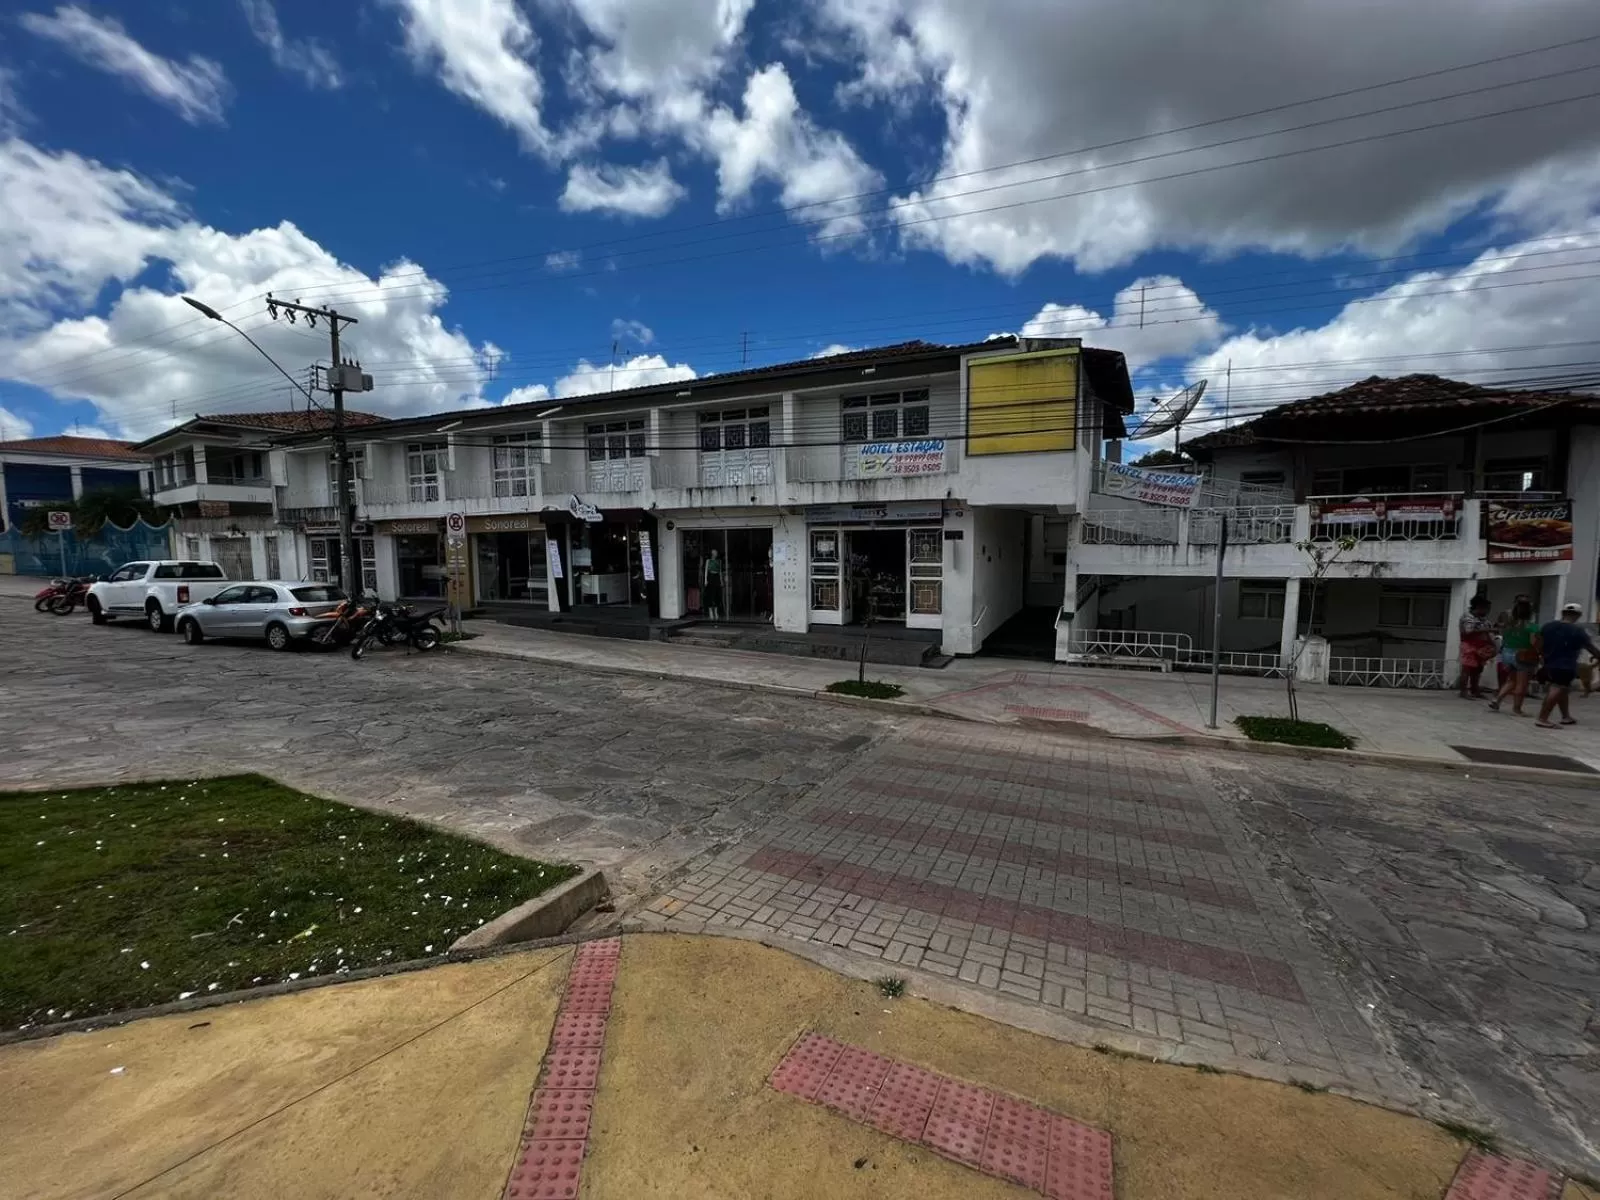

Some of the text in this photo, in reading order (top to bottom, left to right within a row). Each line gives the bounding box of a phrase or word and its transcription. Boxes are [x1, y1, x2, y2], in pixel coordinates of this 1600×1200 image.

[861, 443, 893, 455] HOTEL
[1109, 463, 1142, 479] HOTEL
[391, 522, 430, 533] Sonoreal
[484, 519, 529, 530] Sonoreal
